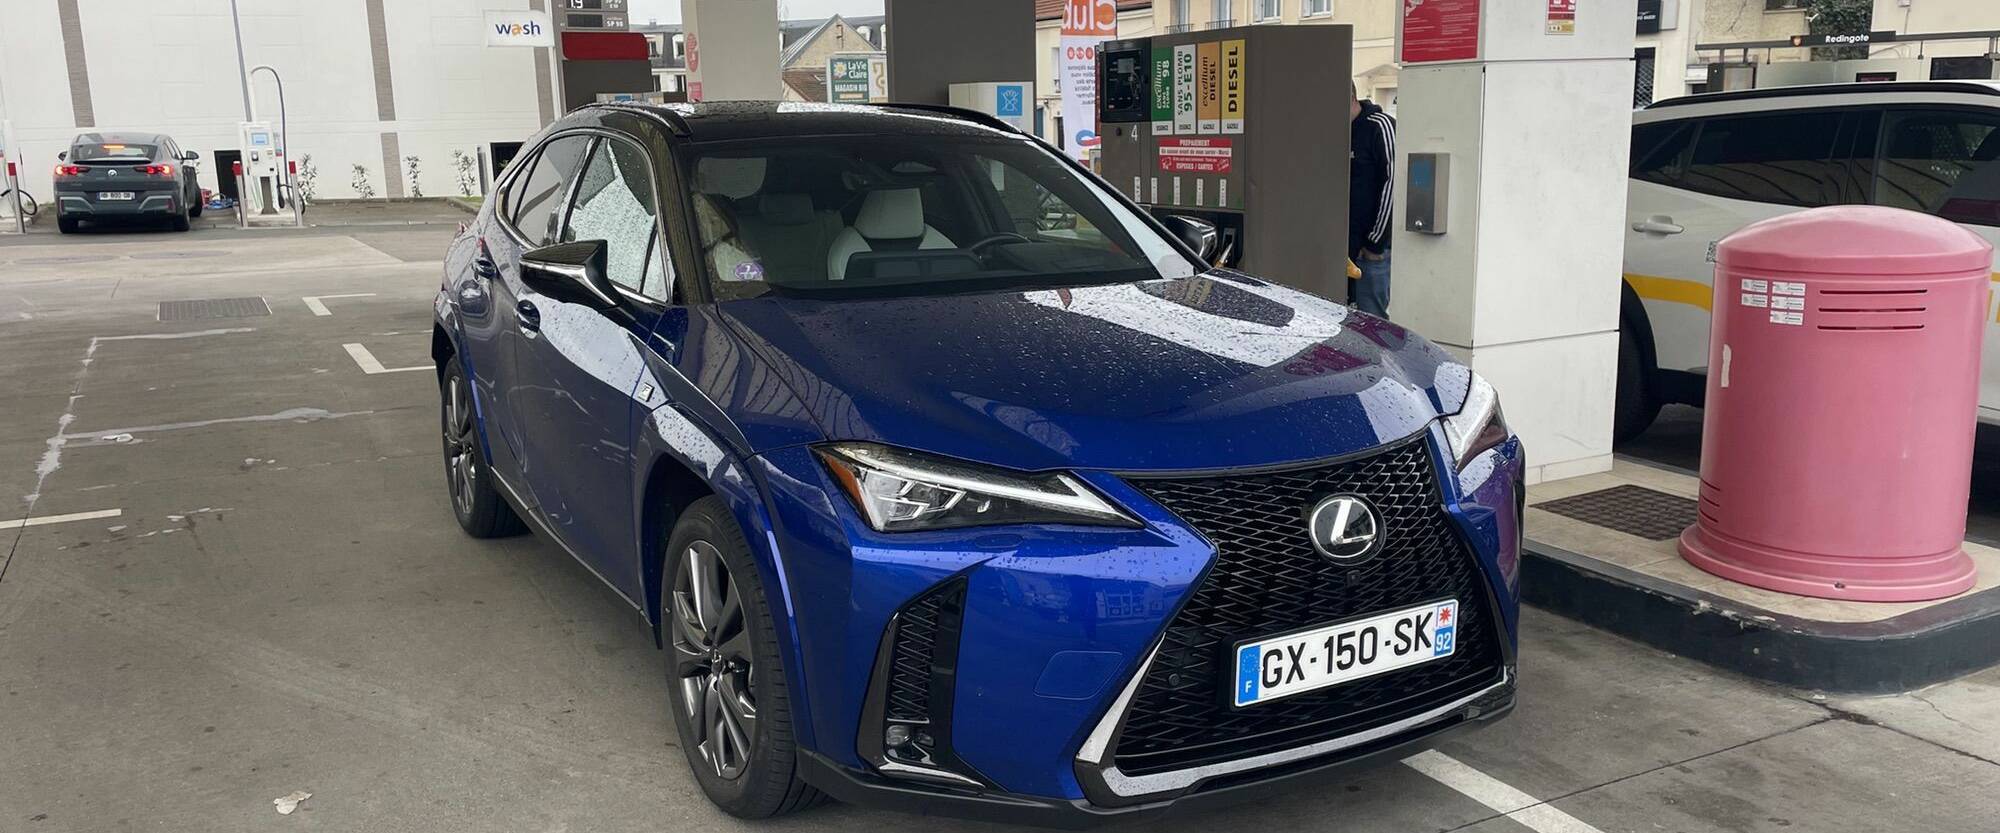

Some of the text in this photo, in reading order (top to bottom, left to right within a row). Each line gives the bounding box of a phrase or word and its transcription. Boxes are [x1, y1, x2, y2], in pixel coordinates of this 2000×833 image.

[495, 20, 541, 36] wash
[1825, 34, 1870, 44] Redingote
[848, 71, 867, 79] Claire
[1183, 53, 1192, 112] 95-E10
[1228, 46, 1238, 113] DIESEL
[1131, 124, 1138, 141] 4
[1245, 611, 1451, 693] F GX-150-SK 92
